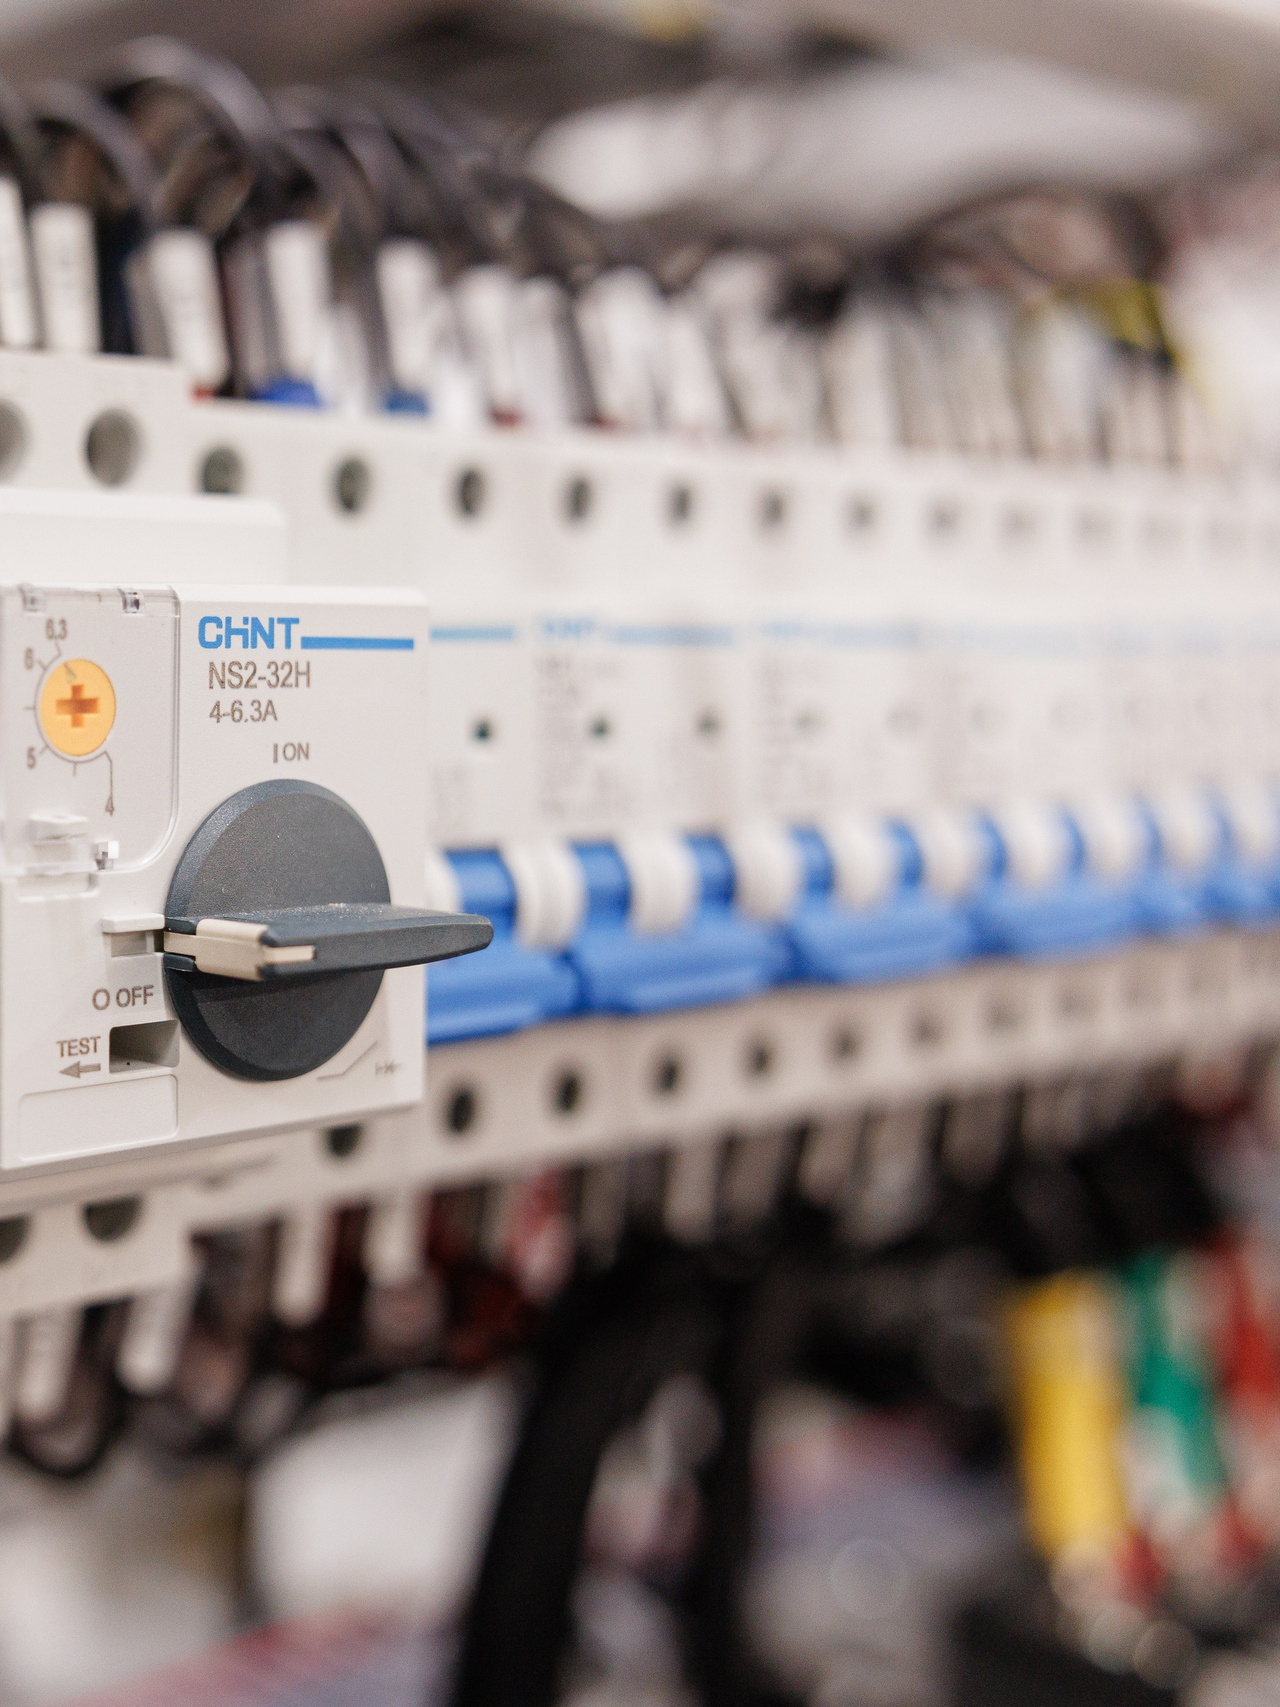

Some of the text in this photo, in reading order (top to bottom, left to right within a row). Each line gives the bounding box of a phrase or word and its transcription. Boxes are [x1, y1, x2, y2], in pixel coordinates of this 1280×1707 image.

[45, 617, 68, 642] 6.3
[208, 660, 312, 690] NS2-32H
[208, 699, 279, 724] 4-6.3A
[26, 746, 37, 770] 5
[282, 742, 310, 762] ON
[104, 796, 115, 817] 4
[115, 984, 155, 1008] OFF
[55, 1035, 102, 1058] TEST
